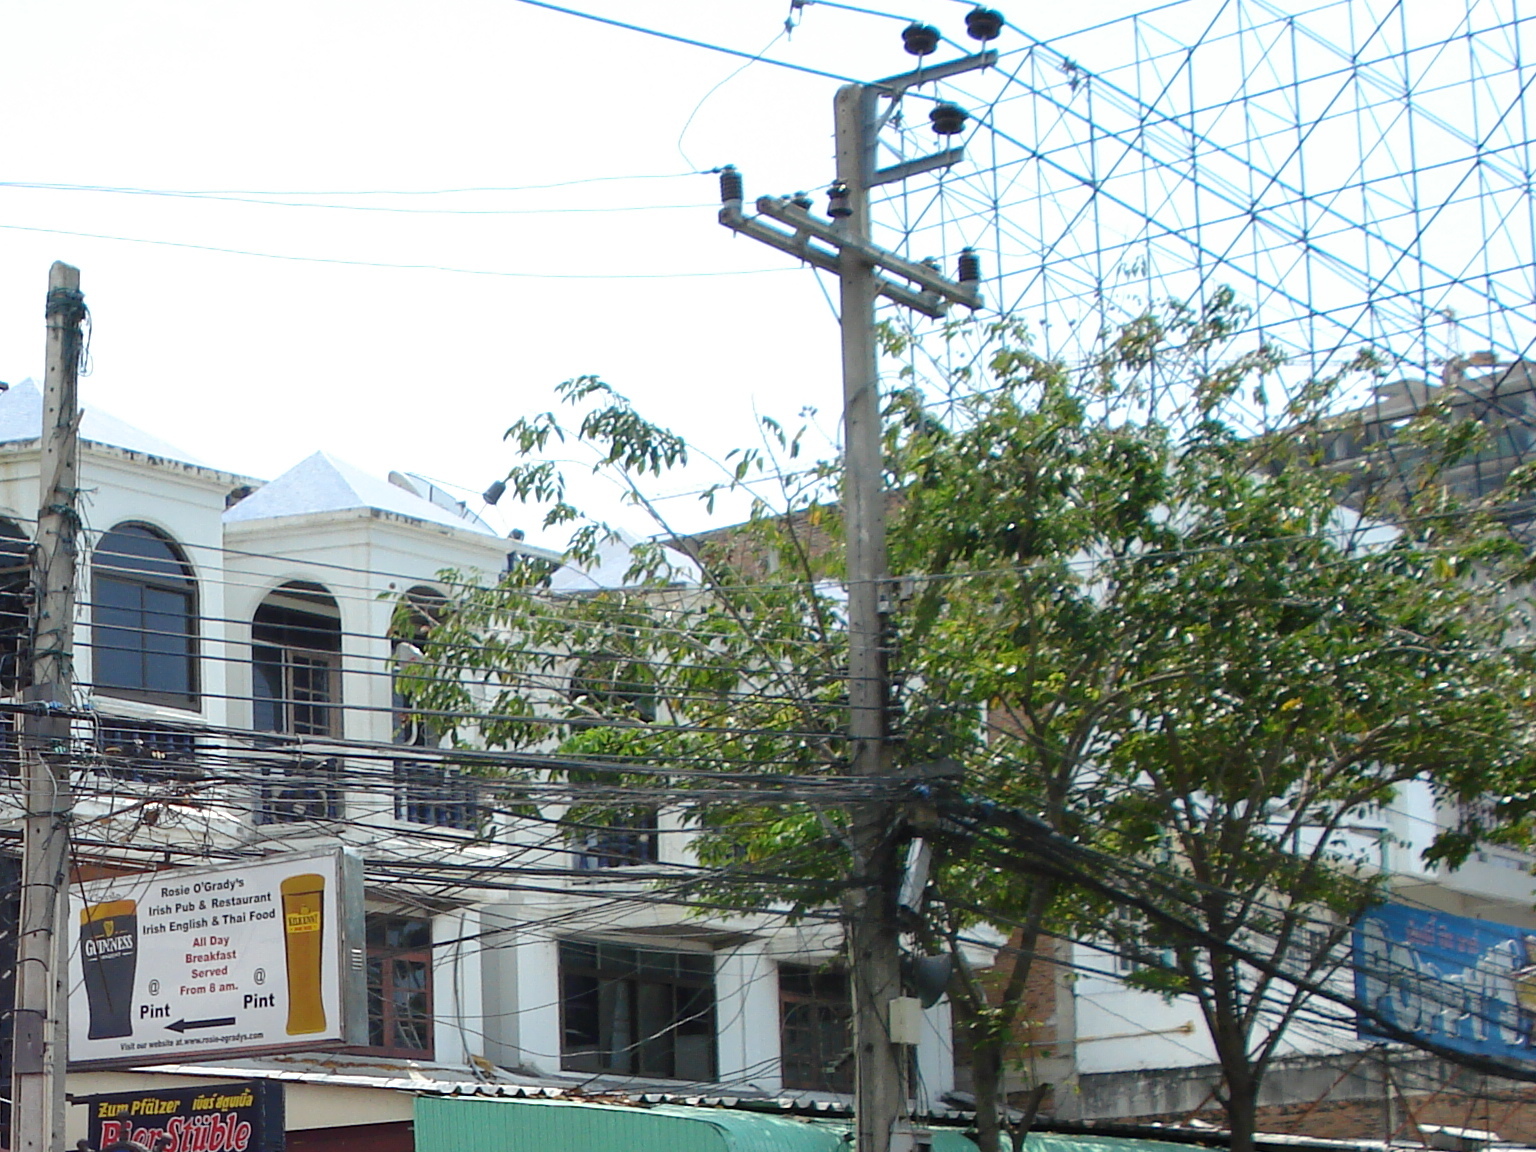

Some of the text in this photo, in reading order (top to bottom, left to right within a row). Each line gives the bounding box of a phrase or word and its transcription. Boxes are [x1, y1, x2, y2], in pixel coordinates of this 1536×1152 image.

[161, 877, 244, 898] Rosie O'Grady's
[148, 892, 272, 917] Irish Pub & Restaurant
[142, 908, 276, 936] Irish English & Thai Food
[85, 934, 134, 957] GUINNESS
[193, 935, 230, 949] All Day
[185, 950, 237, 964] Breakfast
[191, 966, 228, 979] Served
[253, 967, 266, 985] @
[148, 979, 160, 996] @
[180, 984, 206, 996] From
[219, 984, 239, 994] am.
[243, 993, 275, 1009] Pint
[140, 1003, 171, 1019] Pint
[120, 1042, 135, 1051] Visit
[136, 1042, 147, 1050] our
[149, 1040, 173, 1048] website
[98, 1097, 181, 1118] Zum Pfälzer
